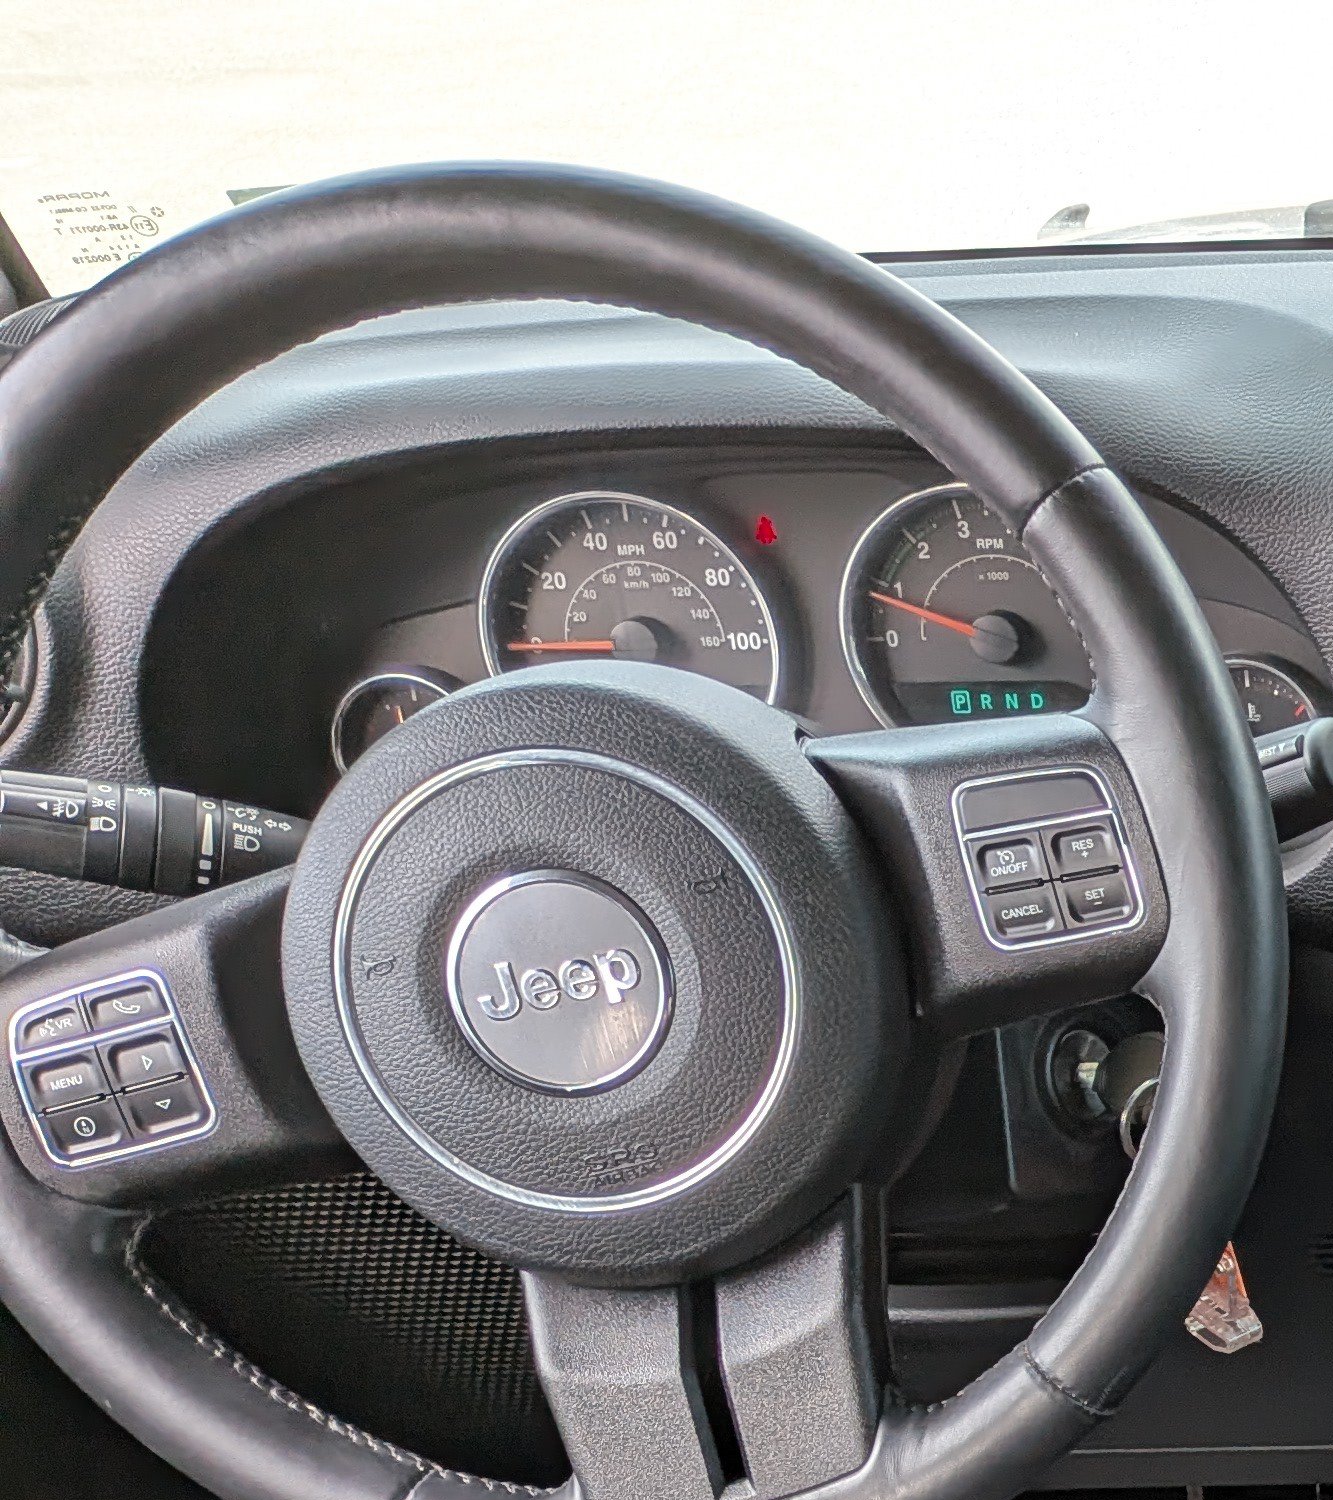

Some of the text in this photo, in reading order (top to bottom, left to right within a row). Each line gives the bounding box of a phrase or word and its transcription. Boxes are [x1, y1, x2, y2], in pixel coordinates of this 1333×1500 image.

[957, 521, 970, 538] 3
[583, 532, 608, 551] 40
[652, 531, 678, 549] 60
[976, 538, 1003, 549] RPM
[617, 544, 645, 556] MPH
[917, 542, 930, 559] 2
[602, 572, 616, 584] 60
[627, 565, 642, 577] 80
[650, 571, 671, 583] 100
[704, 568, 730, 587] 80
[541, 572, 566, 590] 20
[623, 579, 650, 589] km/h
[582, 588, 597, 600] 40
[671, 585, 692, 597] 120
[893, 582, 904, 599] 1
[572, 611, 587, 622] 20
[689, 607, 710, 620] 140
[700, 635, 721, 647] 160
[726, 632, 762, 650] 100
[886, 630, 899, 647] 0
[981, 694, 993, 710] R
[1005, 694, 1019, 710] N
[1030, 694, 1044, 710] D
[232, 822, 263, 836] PUSH
[1072, 838, 1094, 852] RES
[990, 861, 1028, 877] ON/OFF
[1085, 888, 1105, 901] SET
[1001, 903, 1043, 920] CANCEL
[477, 948, 641, 1022] Jeep
[56, 1017, 73, 1030] VR
[50, 1074, 83, 1092] MENU
